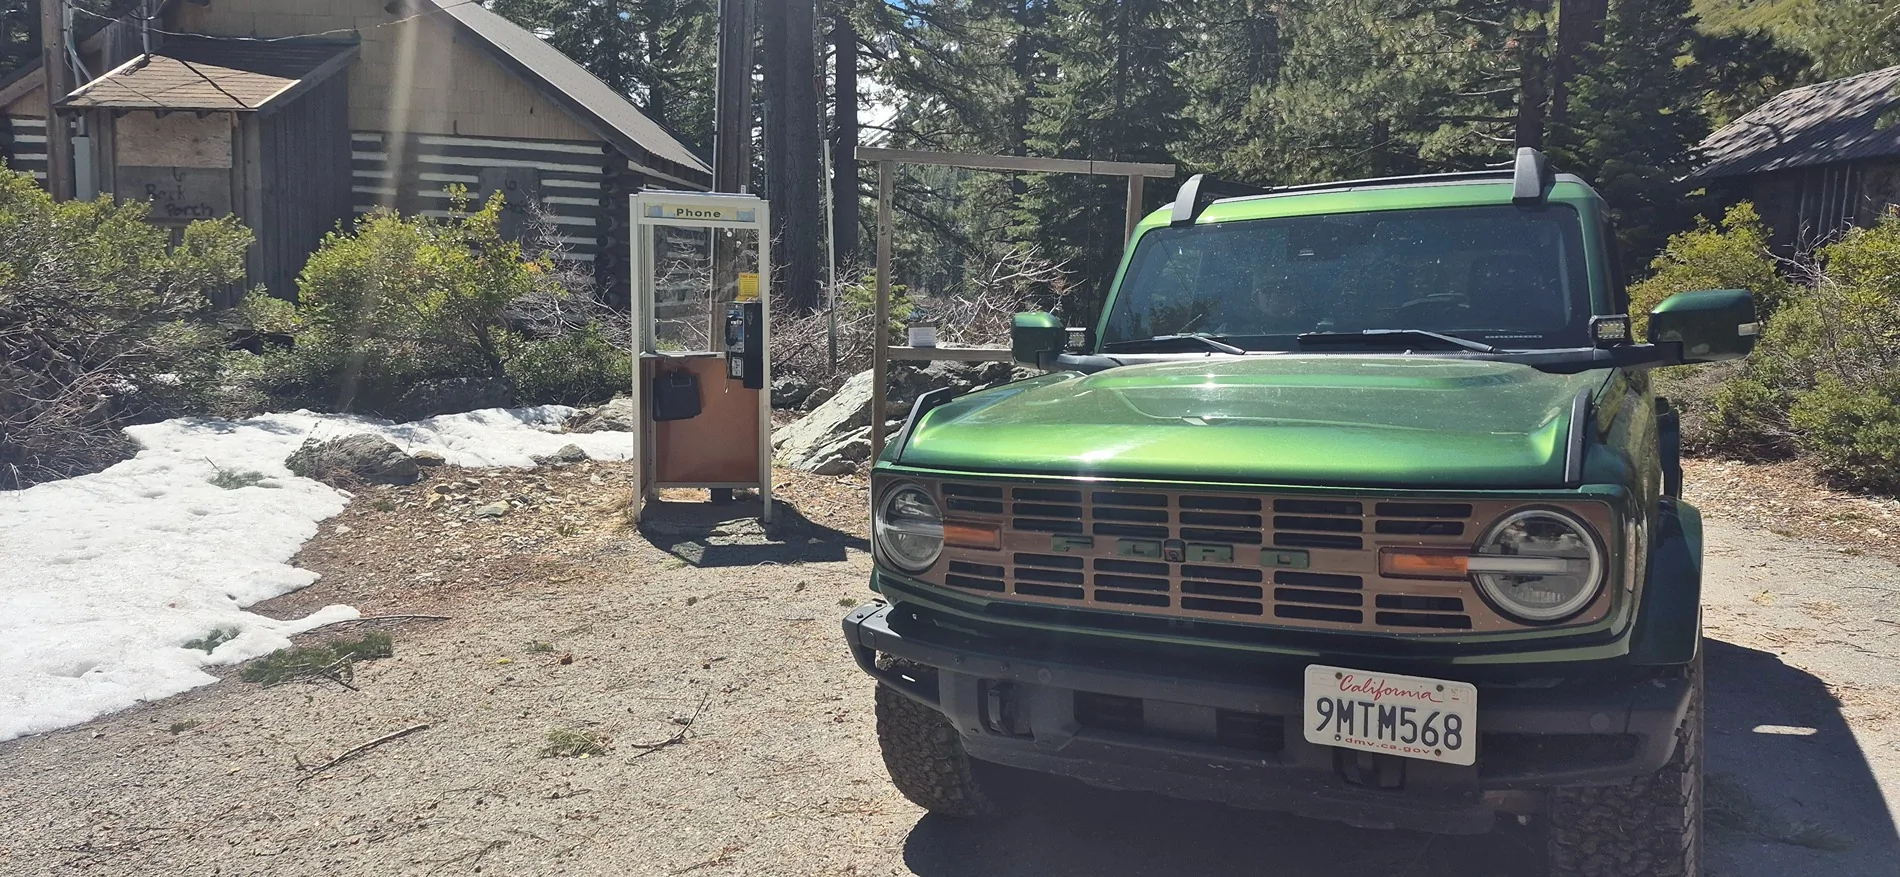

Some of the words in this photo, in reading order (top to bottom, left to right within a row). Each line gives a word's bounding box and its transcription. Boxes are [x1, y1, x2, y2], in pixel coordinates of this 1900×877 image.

[676, 208, 722, 218] Phone
[1051, 533, 1310, 569] FORD
[1339, 674, 1443, 702] California
[1316, 697, 1463, 750] 9MTM568
[1345, 737, 1431, 755] dmv.ca.gov
